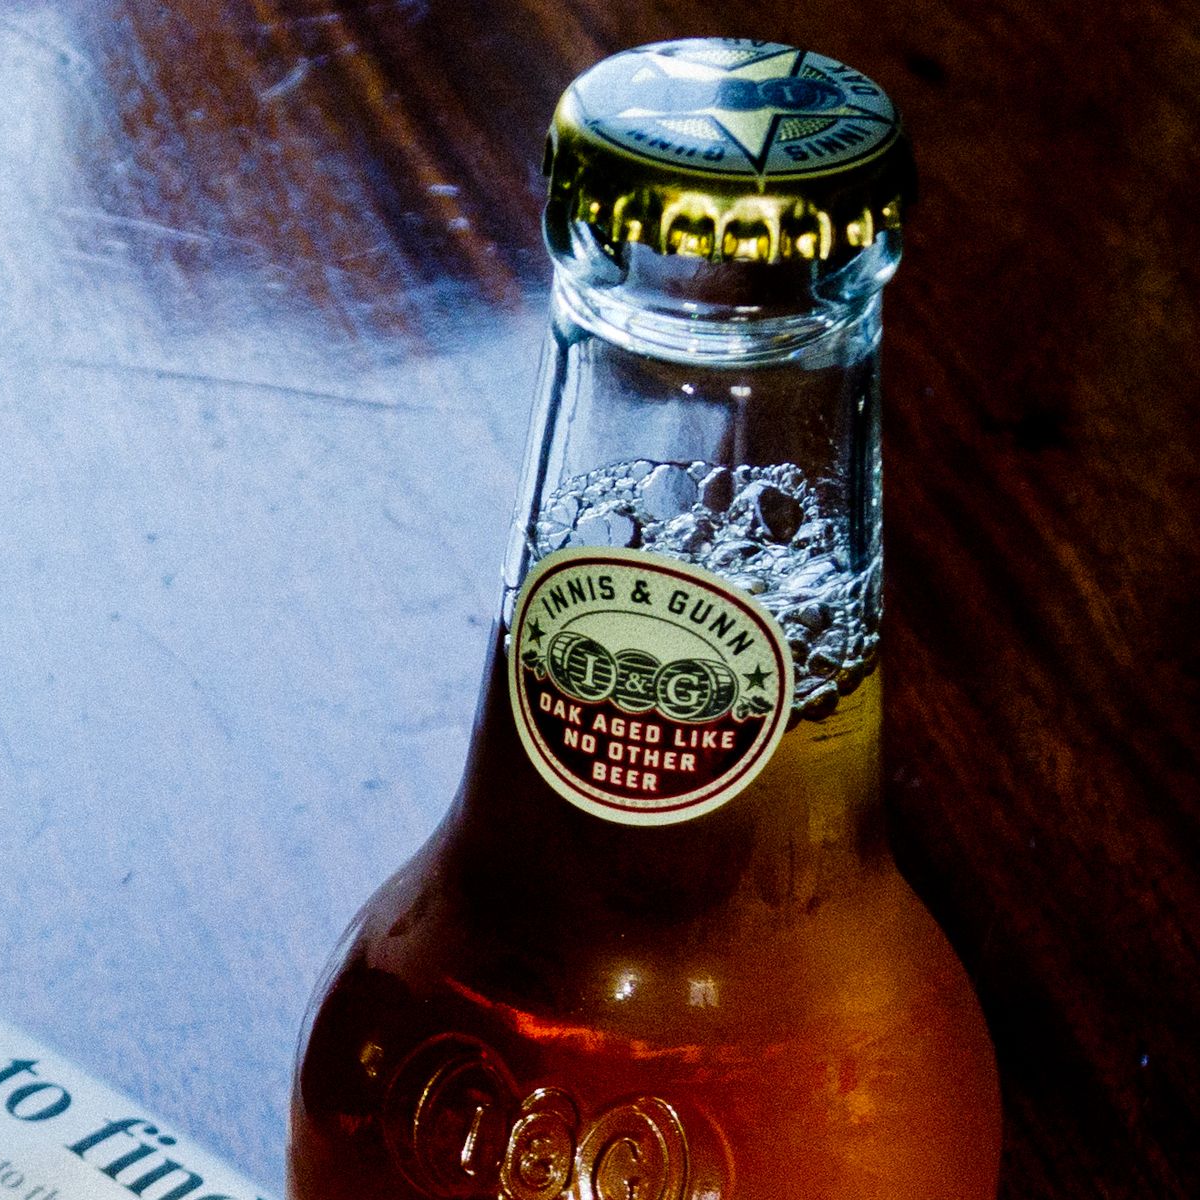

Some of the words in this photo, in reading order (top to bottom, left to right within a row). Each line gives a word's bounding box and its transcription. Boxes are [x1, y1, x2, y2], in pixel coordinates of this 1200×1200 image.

[783, 124, 867, 162] INNIS
[541, 575, 615, 620] INNIS
[630, 579, 653, 606] &
[668, 590, 755, 656] GUNN
[667, 674, 701, 706] G
[539, 692, 582, 725] OAK
[592, 713, 661, 744] AGED
[674, 728, 735, 749] LIKE
[564, 728, 596, 754] NO
[608, 742, 696, 772] OTHER
[593, 761, 658, 791] BEER
